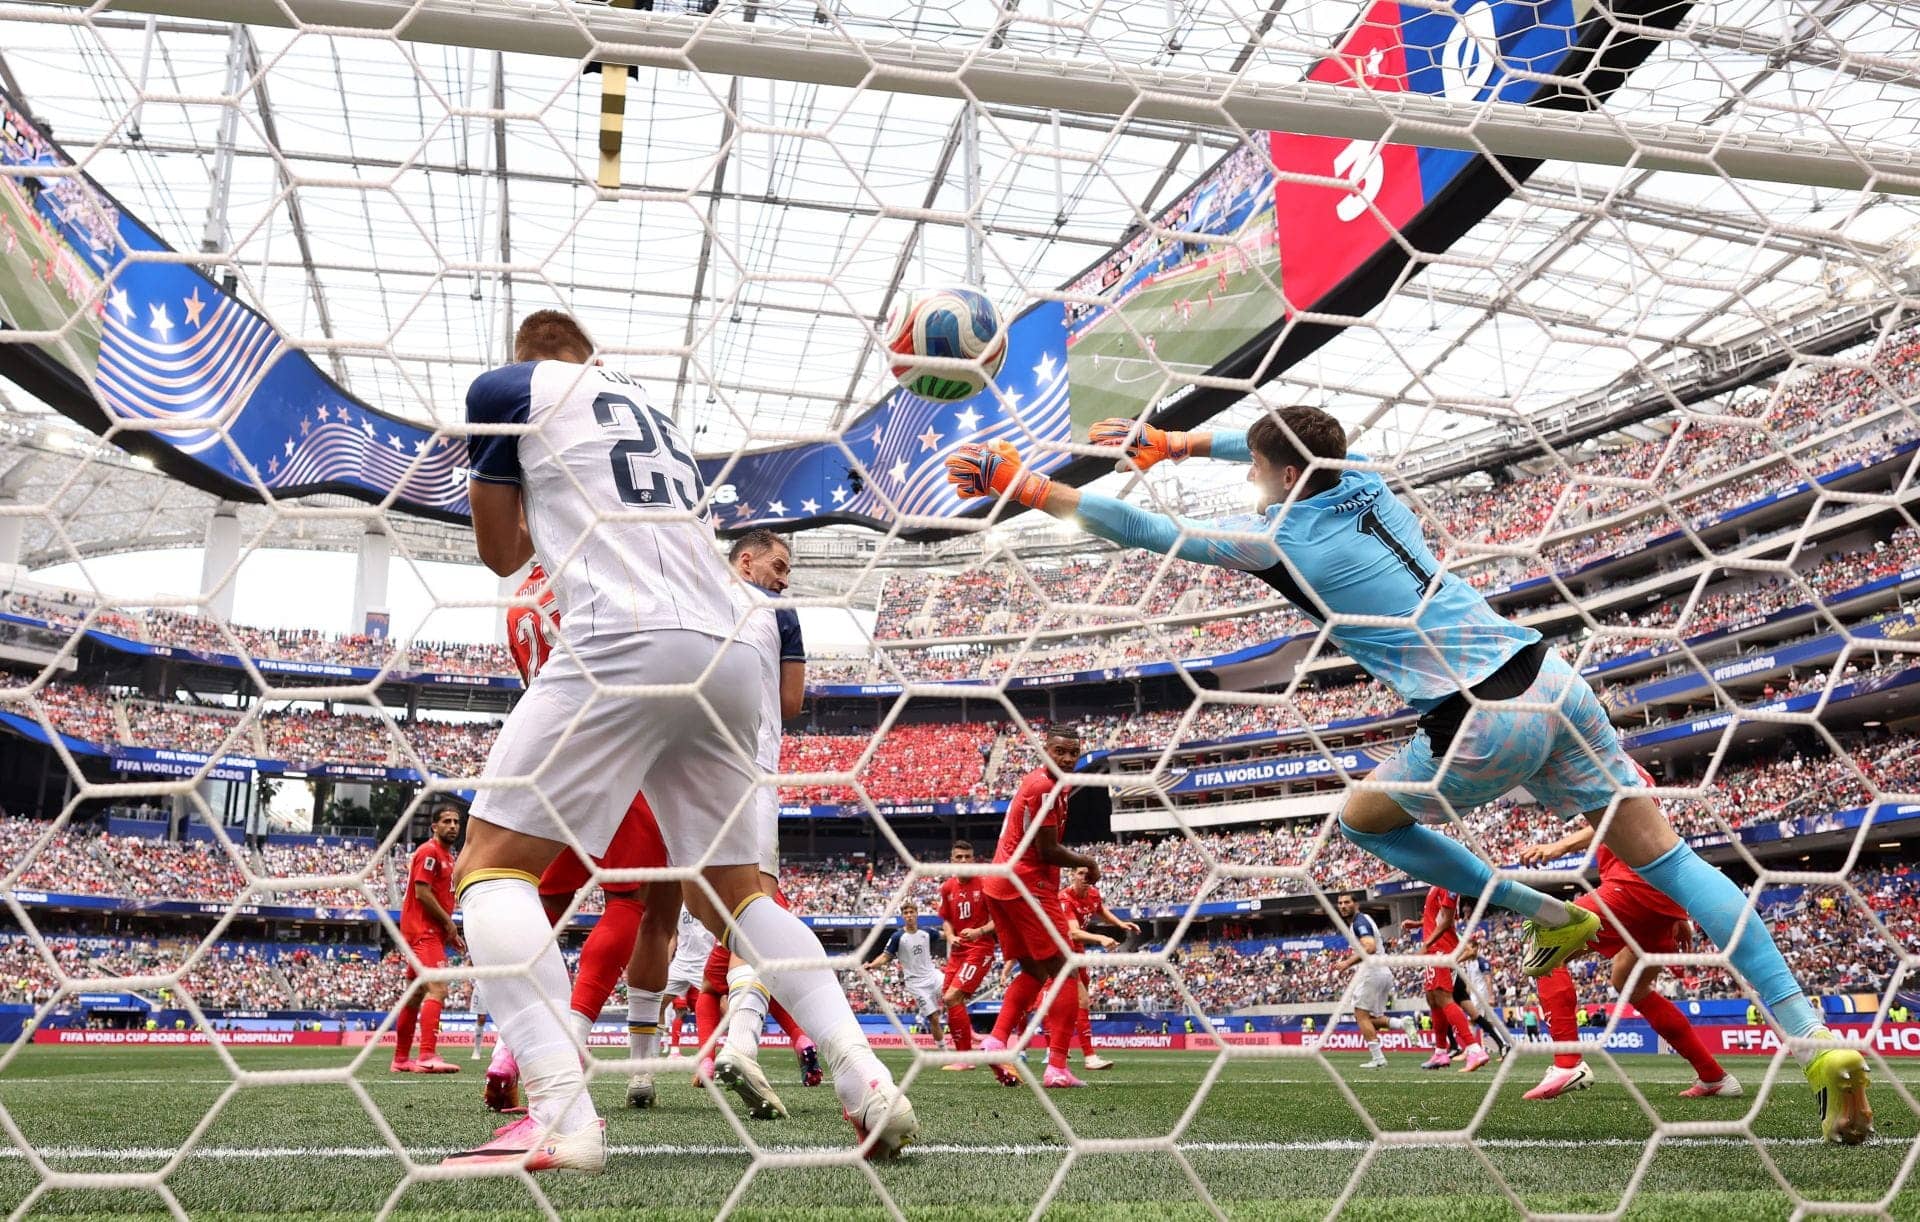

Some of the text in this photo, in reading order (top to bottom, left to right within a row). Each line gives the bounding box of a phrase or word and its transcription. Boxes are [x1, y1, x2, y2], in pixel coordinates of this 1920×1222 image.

[592, 391, 713, 525] 25
[1357, 503, 1446, 600] 1
[259, 660, 277, 670] FIFA
[278, 662, 306, 673] WORLD
[307, 664, 323, 674] CUP
[156, 751, 175, 761] FIFA
[176, 752, 209, 763] WORLD
[116, 760, 141, 771] FIFA
[142, 761, 183, 774] WORLD
[1195, 774, 1223, 787] FIFA
[1225, 768, 1273, 784] WORLD
[1276, 763, 1303, 776] CUP
[958, 901, 971, 920] 10
[959, 962, 977, 980] 10
[60, 1032, 84, 1042] FIFA
[85, 1032, 124, 1042] WORLD
[126, 1032, 147, 1042] CUP
[233, 1033, 294, 1043] HOSPITALITY
